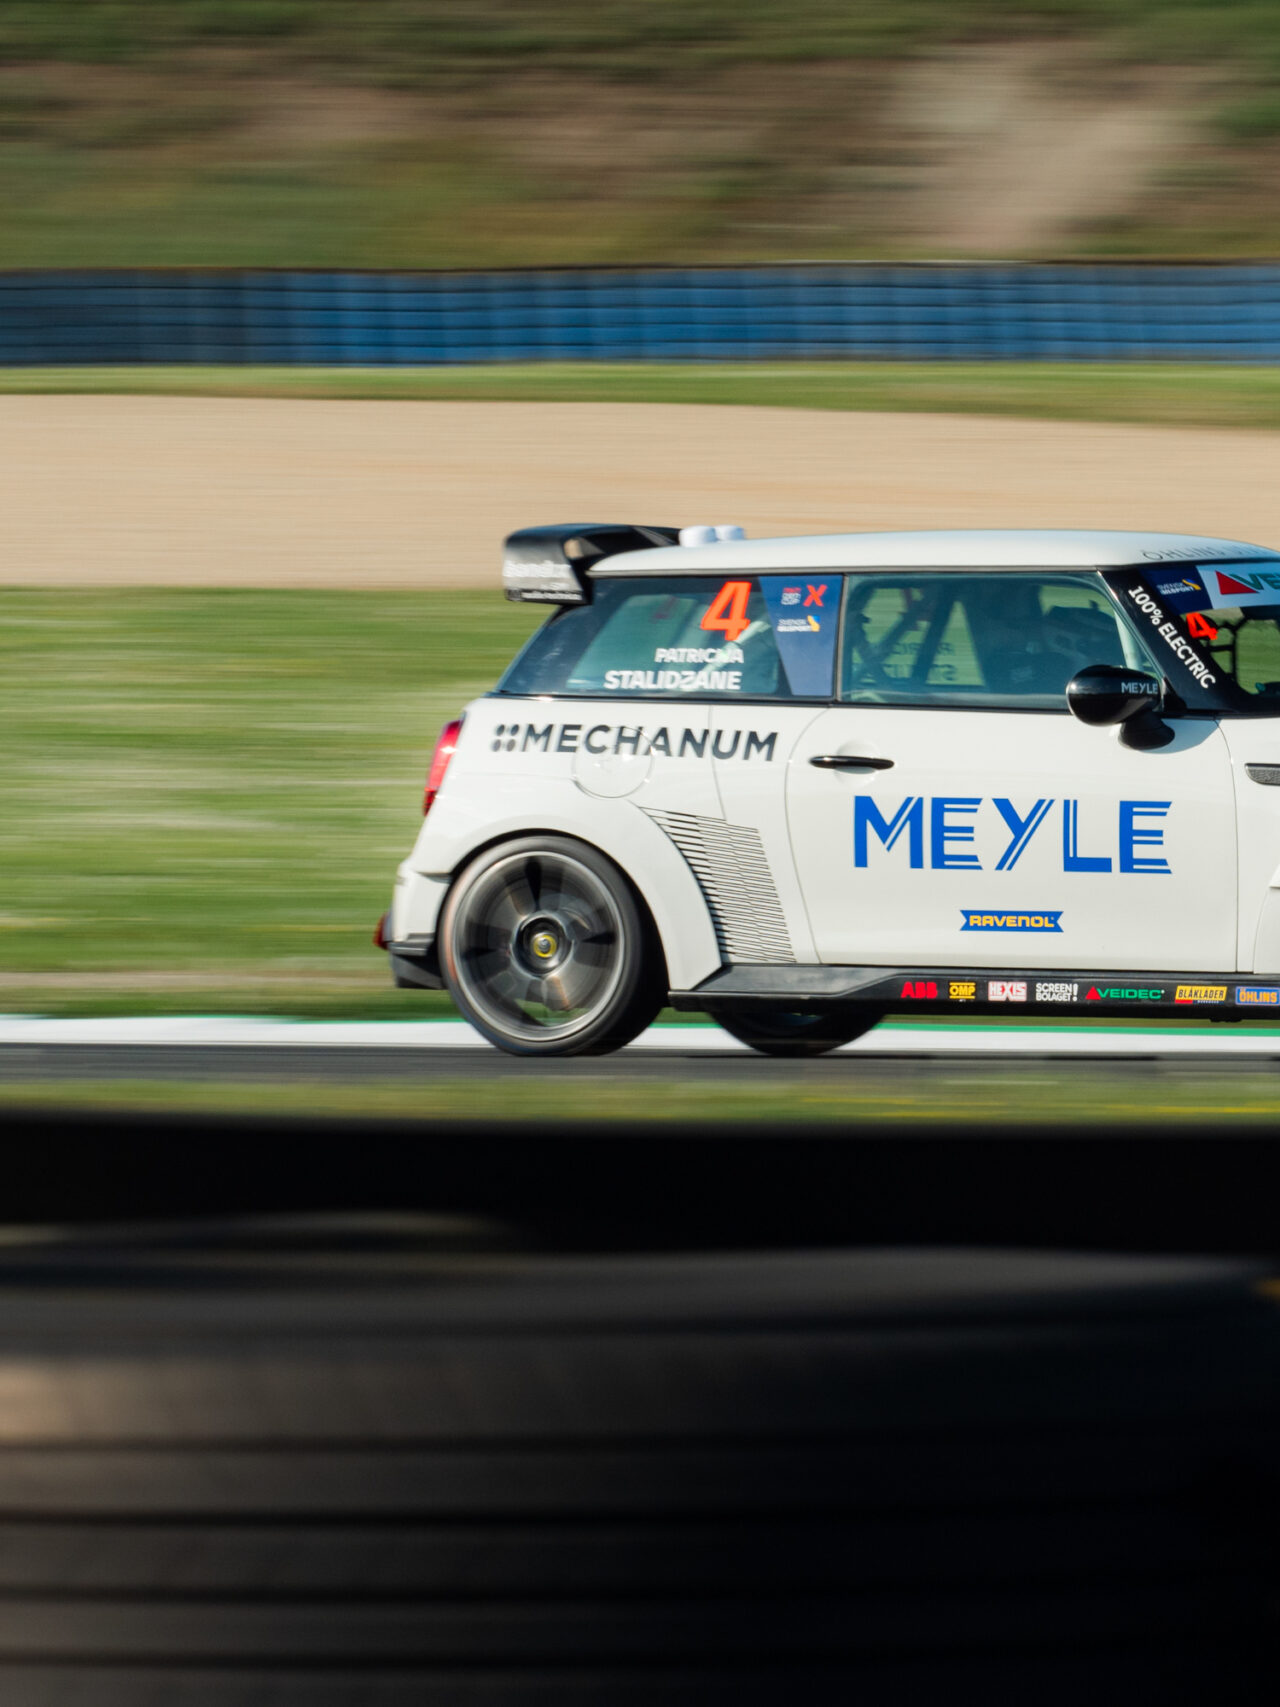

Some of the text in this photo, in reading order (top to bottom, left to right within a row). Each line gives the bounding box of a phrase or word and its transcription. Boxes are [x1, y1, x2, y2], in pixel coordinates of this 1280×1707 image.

[700, 581, 752, 641] 4
[1185, 612, 1218, 640] 4
[1128, 586, 1216, 688] 100% ELECTRIC
[1121, 682, 1158, 694] MEYLE
[521, 723, 778, 761] MECHANUM
[853, 796, 1172, 875] MEYLE
[969, 915, 1054, 927] RAVENOL
[901, 981, 938, 999] ABB
[949, 985, 976, 996] OMP
[989, 982, 1027, 1001] HEXIS
[1097, 988, 1162, 999] VEIDEC
